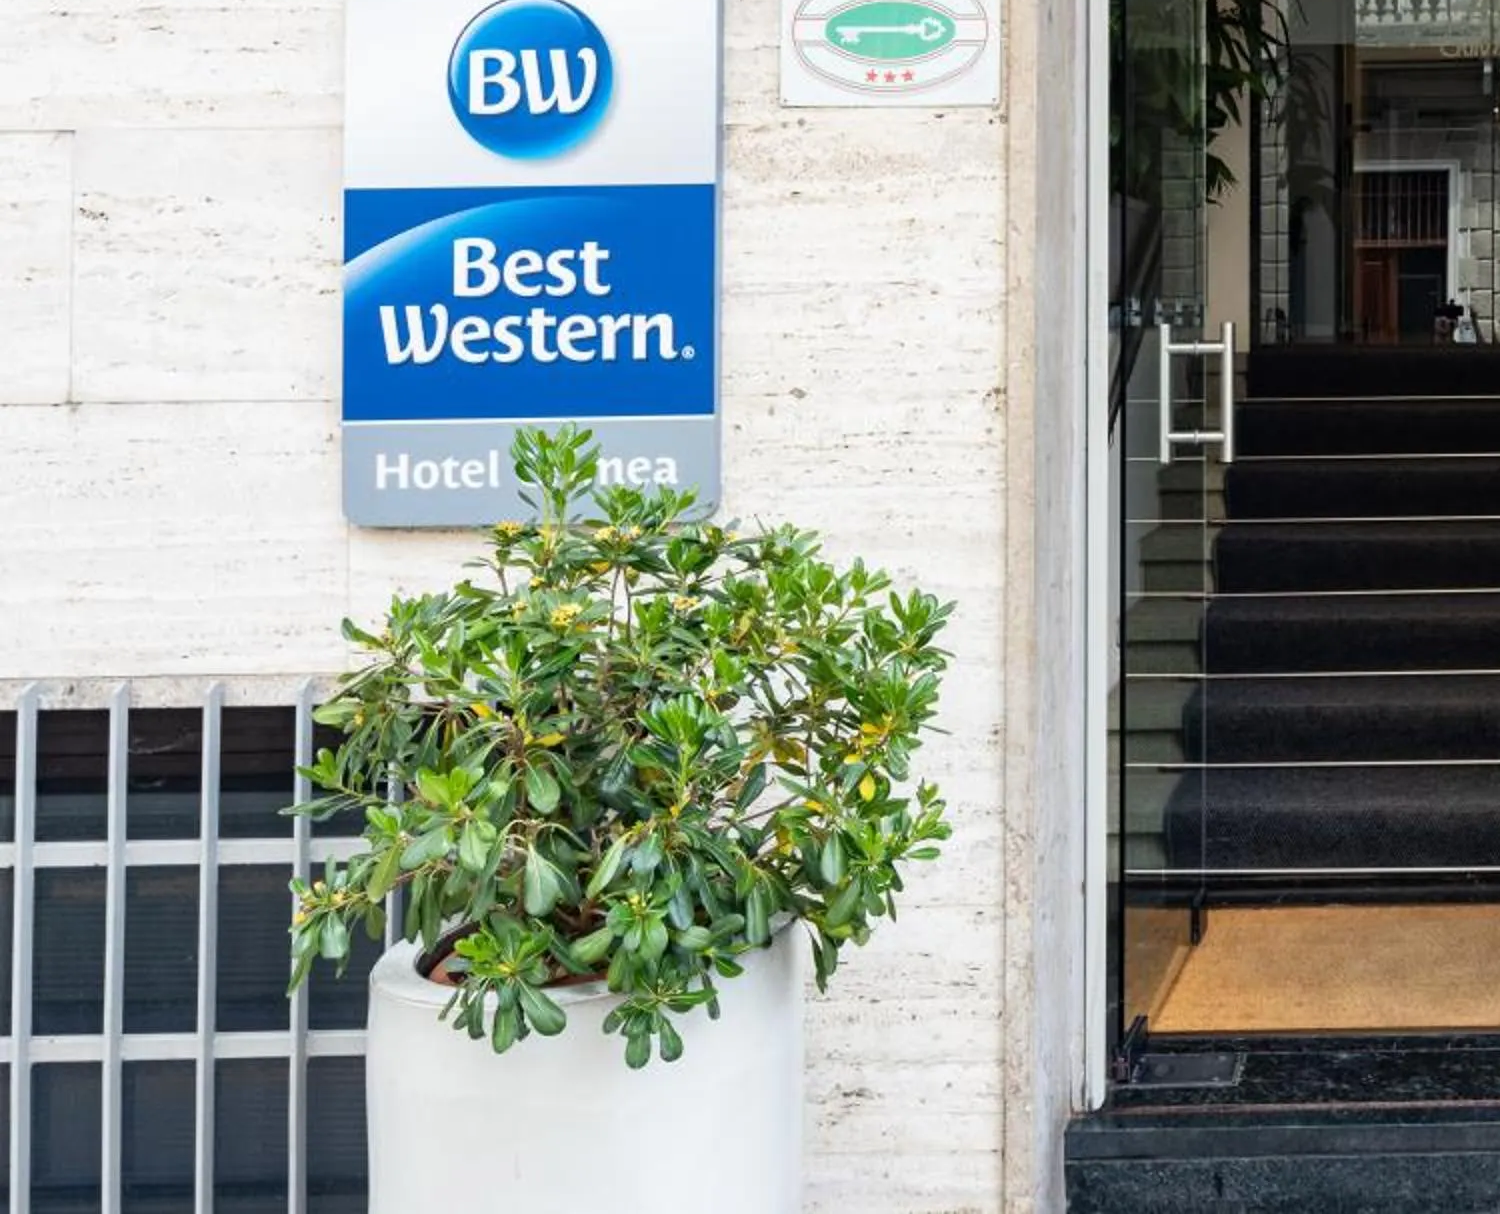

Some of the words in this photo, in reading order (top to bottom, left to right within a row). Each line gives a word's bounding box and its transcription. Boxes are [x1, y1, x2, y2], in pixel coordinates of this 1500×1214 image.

[468, 49, 598, 115] BW
[452, 236, 612, 297] Best
[375, 450, 498, 489] Hotel
